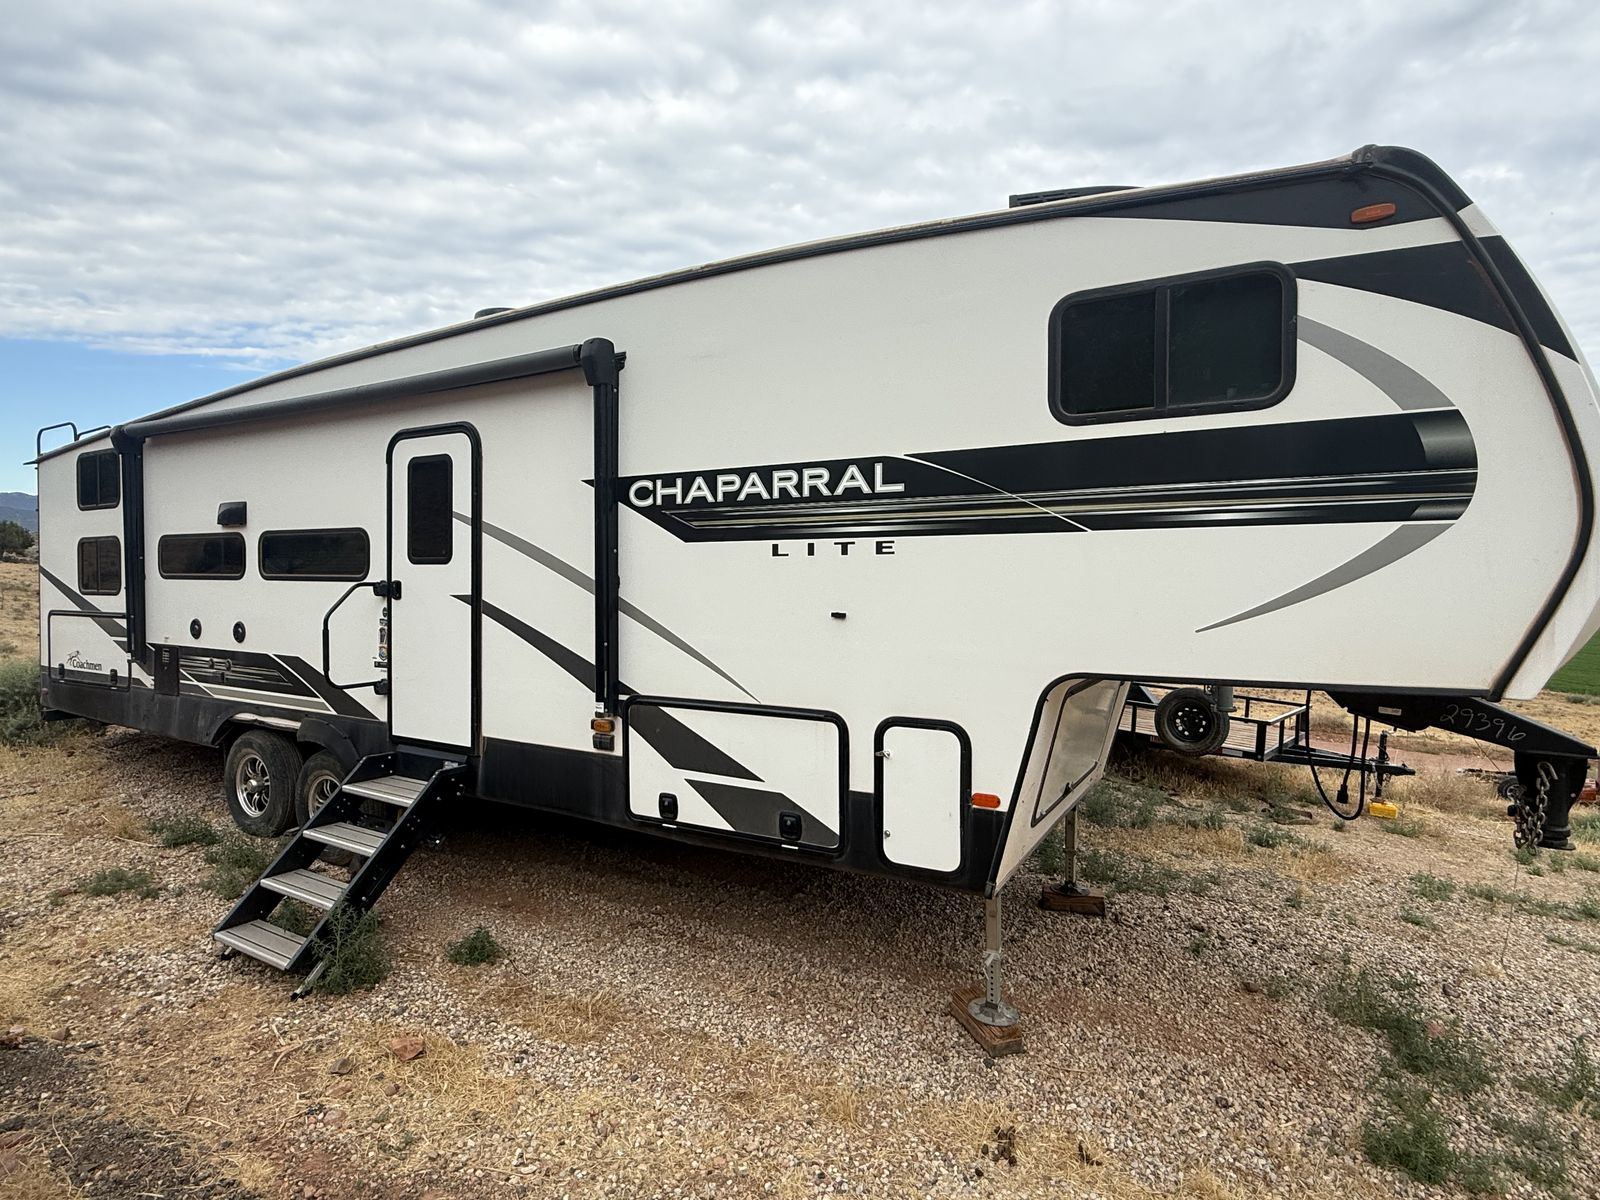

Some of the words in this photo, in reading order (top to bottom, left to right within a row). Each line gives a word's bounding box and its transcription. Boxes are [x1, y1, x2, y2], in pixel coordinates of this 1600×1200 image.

[629, 462, 905, 507] CHAPARRAL
[771, 540, 895, 557] LITE
[1440, 704, 1527, 741] 29396
